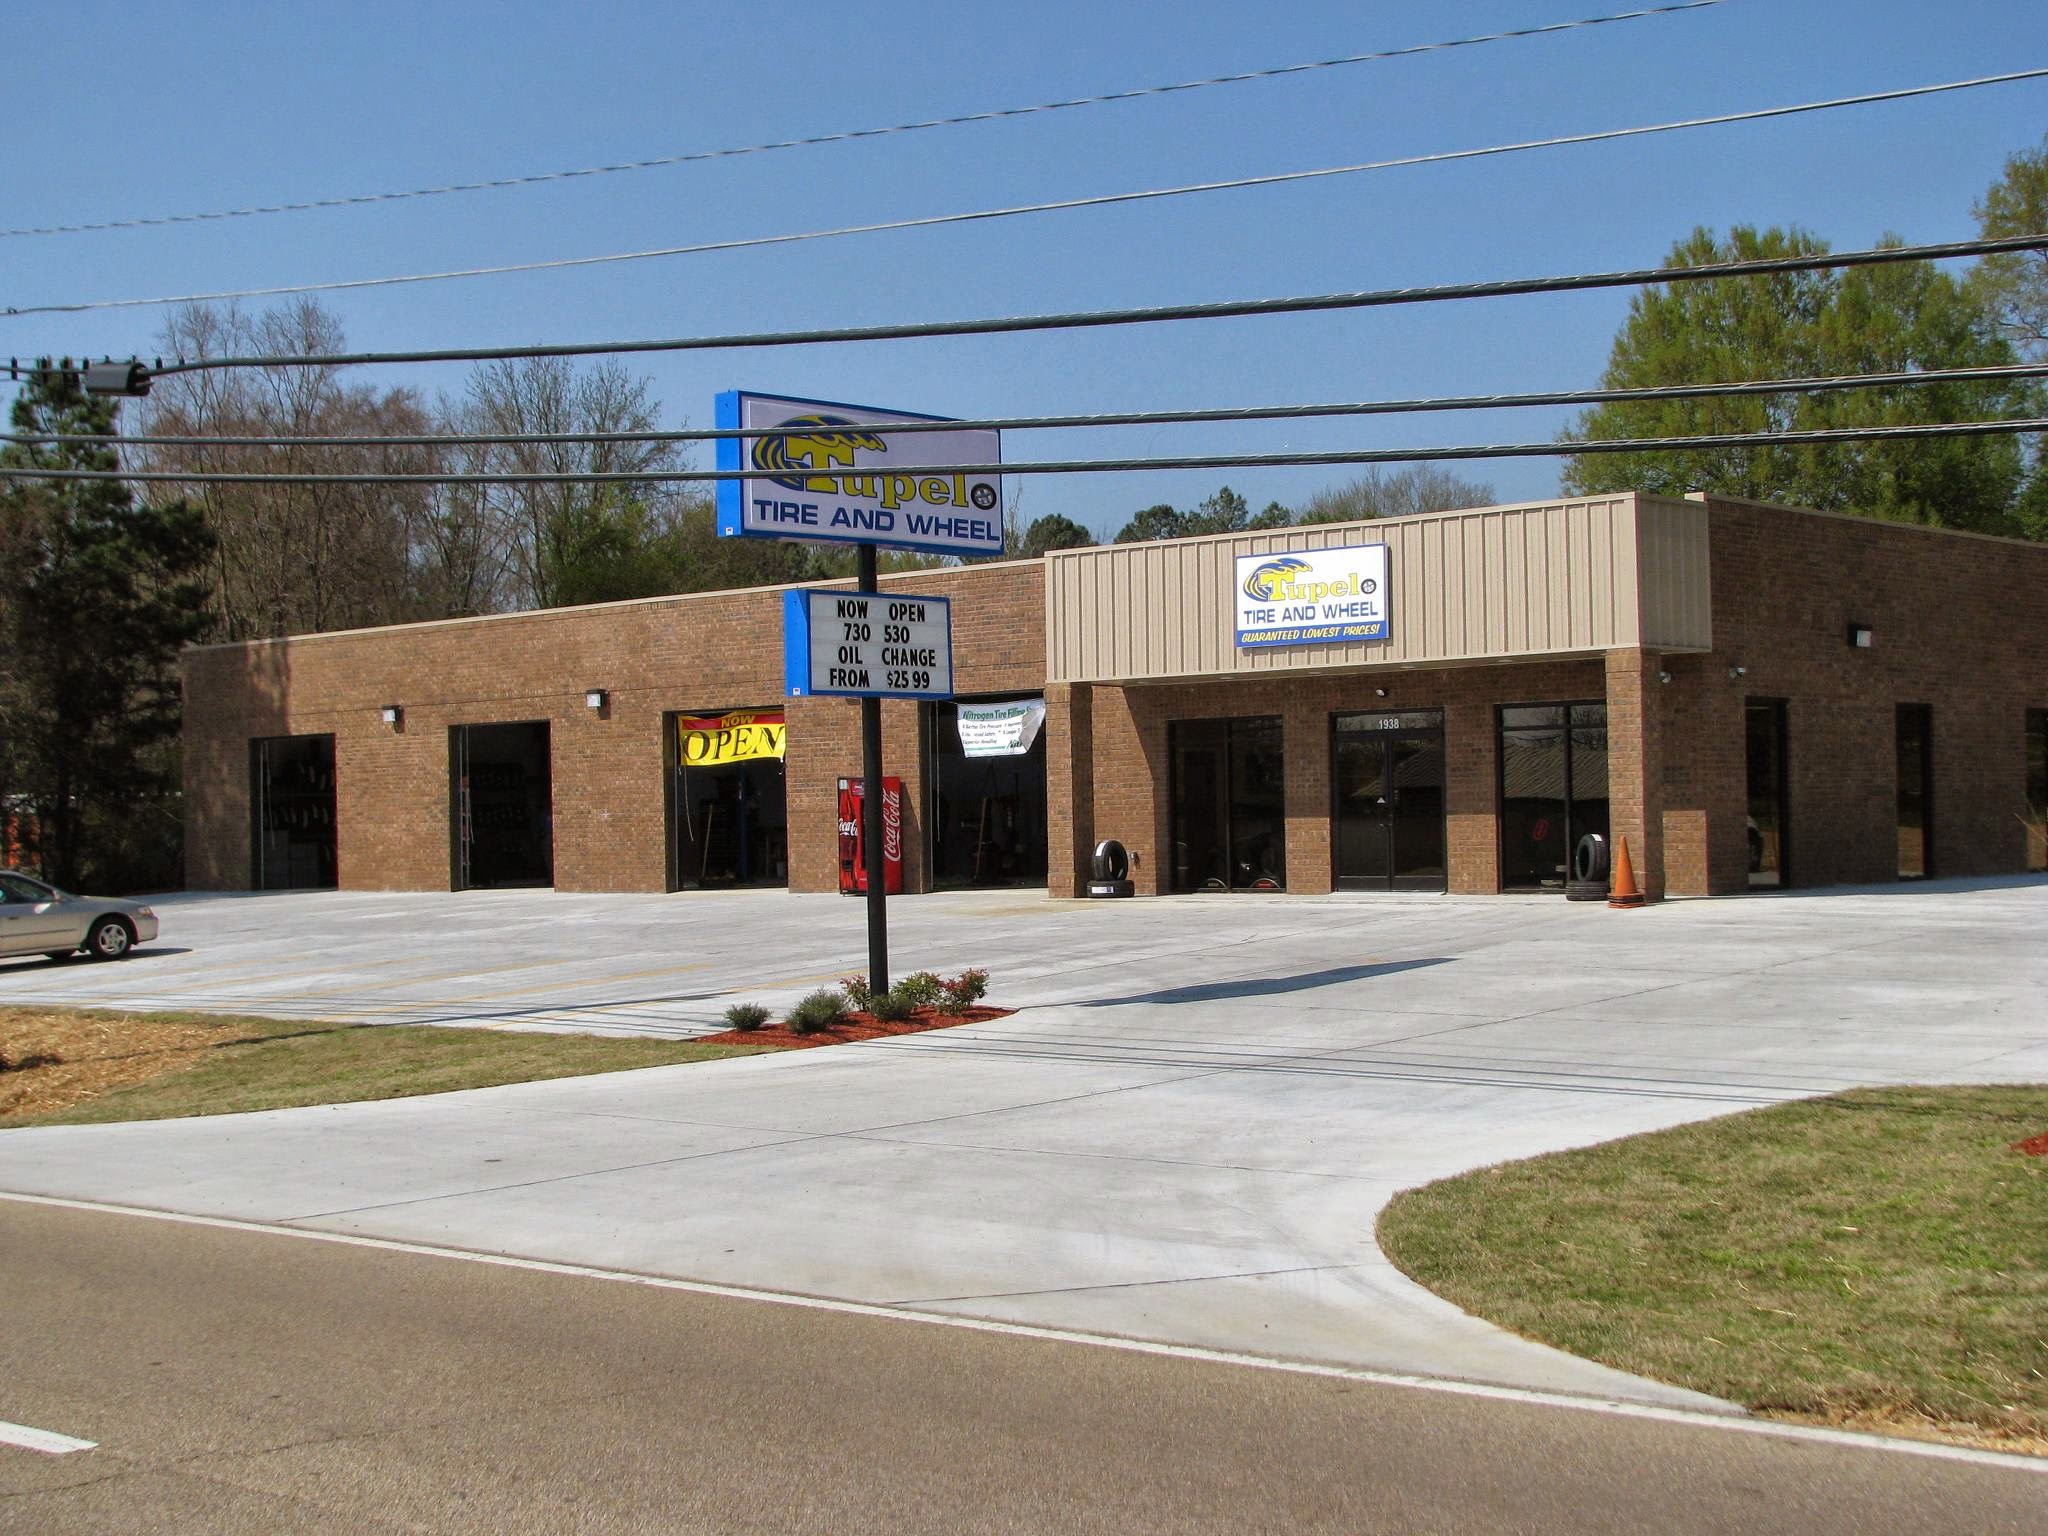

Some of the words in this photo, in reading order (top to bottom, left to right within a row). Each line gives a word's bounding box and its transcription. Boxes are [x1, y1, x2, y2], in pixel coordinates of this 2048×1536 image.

[754, 500, 818, 525] TIRE
[830, 507, 894, 532] AND
[906, 514, 1000, 541] WHEEL
[837, 600, 868, 619] NOW
[889, 603, 925, 622] OPEN
[1244, 608, 1275, 624] TIRE
[1282, 605, 1315, 622] AND
[1322, 601, 1378, 619] WHEEL
[844, 623, 870, 641] 730
[884, 626, 910, 643] 530
[1241, 629, 1299, 643] GUARANTEED
[1302, 626, 1340, 639] LOWEST
[1343, 623, 1380, 636] PRICES!
[838, 646, 863, 664] OIL
[881, 648, 936, 667] CHANGE
[830, 668, 870, 687] FROM
[721, 715, 755, 728] NOW
[963, 710, 994, 721] Nitrogen
[994, 709, 1007, 719] Tire
[1379, 718, 1400, 730] 1938
[682, 726, 785, 760] OPEN
